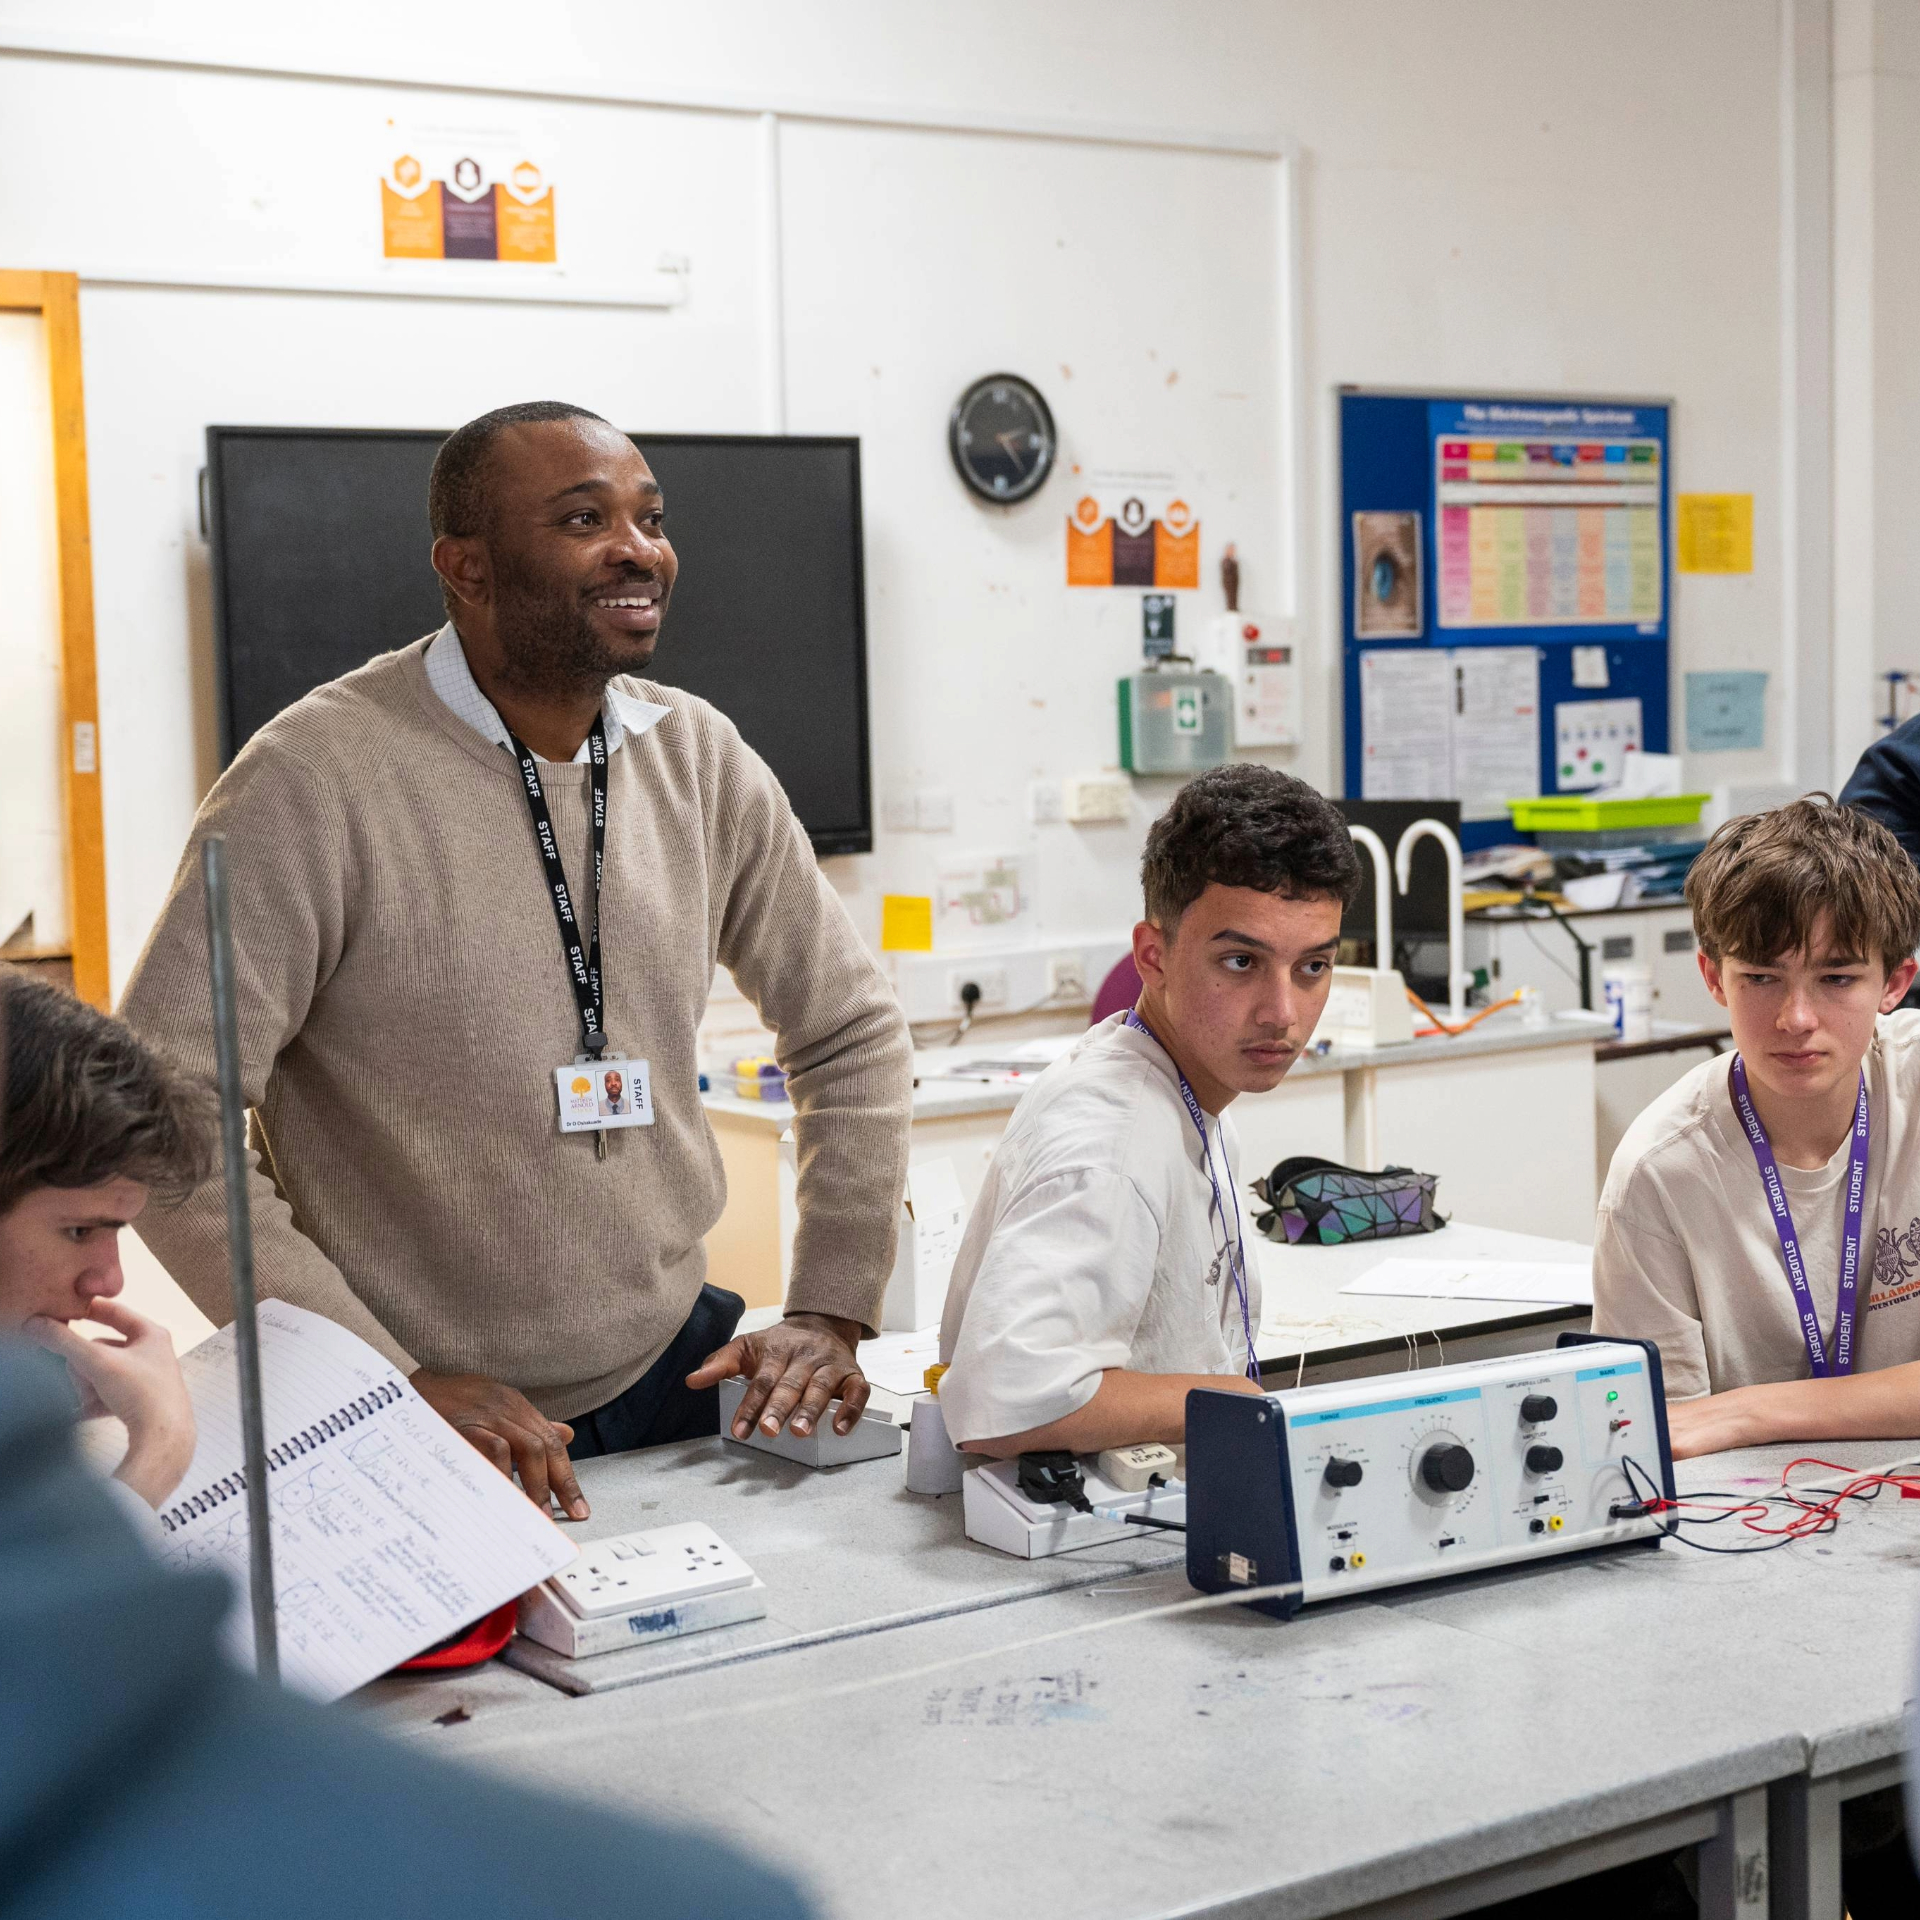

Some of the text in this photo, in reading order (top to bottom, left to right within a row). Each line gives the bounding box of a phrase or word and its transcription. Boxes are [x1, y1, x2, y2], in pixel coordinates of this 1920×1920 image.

[592, 735, 605, 765] STAFF
[522, 758, 541, 798] STAFF
[594, 788, 604, 827] STAFF
[538, 821, 557, 860] STAFF
[555, 883, 574, 923] STAFF
[570, 946, 588, 985] STAFF
[633, 1078, 644, 1110] STAFF
[1738, 1094, 1765, 1145] STUDENT
[1764, 1165, 1788, 1218] STUDENT
[1849, 1159, 1864, 1213] STUDENT
[1785, 1240, 1806, 1292] STUDENT
[1843, 1235, 1857, 1289] STUDENT
[1867, 1294, 1911, 1312] DVENTURE
[1804, 1312, 1825, 1364] STUDENT
[1838, 1310, 1852, 1365] STUDENT
[1599, 1368, 1616, 1376] MAINS
[1414, 1395, 1449, 1406] FREQUENCY
